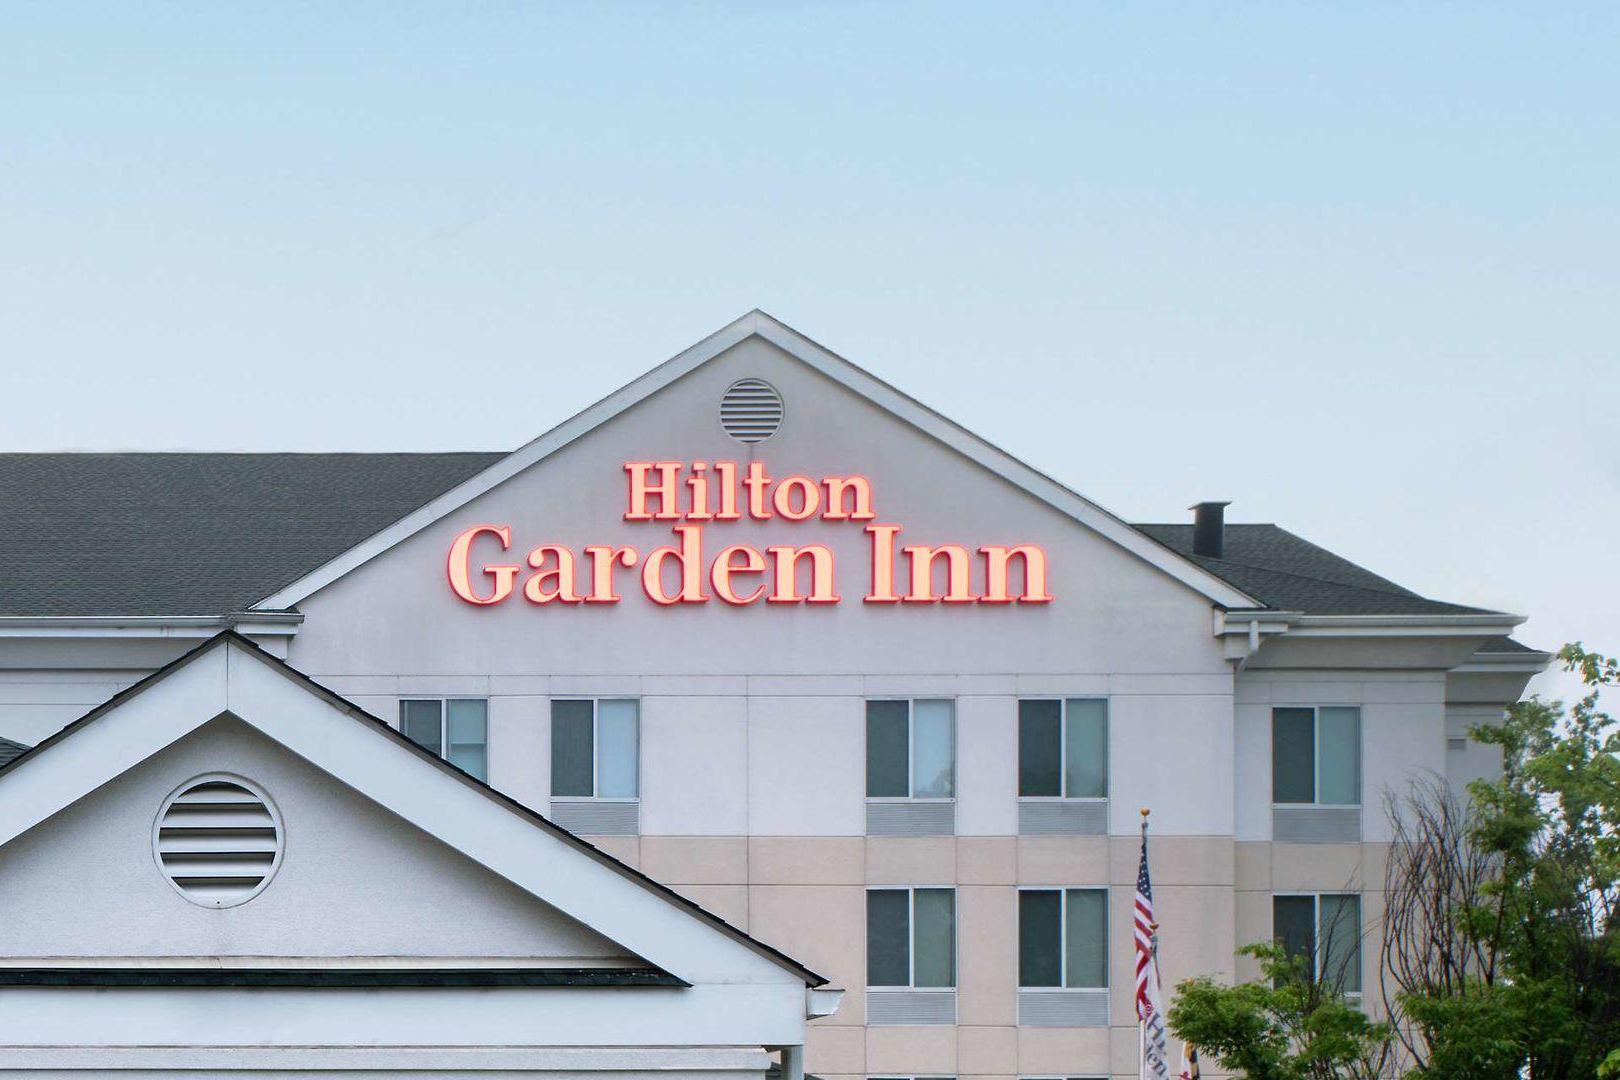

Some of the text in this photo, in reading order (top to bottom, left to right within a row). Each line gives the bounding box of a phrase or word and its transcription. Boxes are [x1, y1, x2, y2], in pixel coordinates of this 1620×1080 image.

[622, 461, 875, 522] Hilton
[446, 524, 1054, 604] Garden Inn
